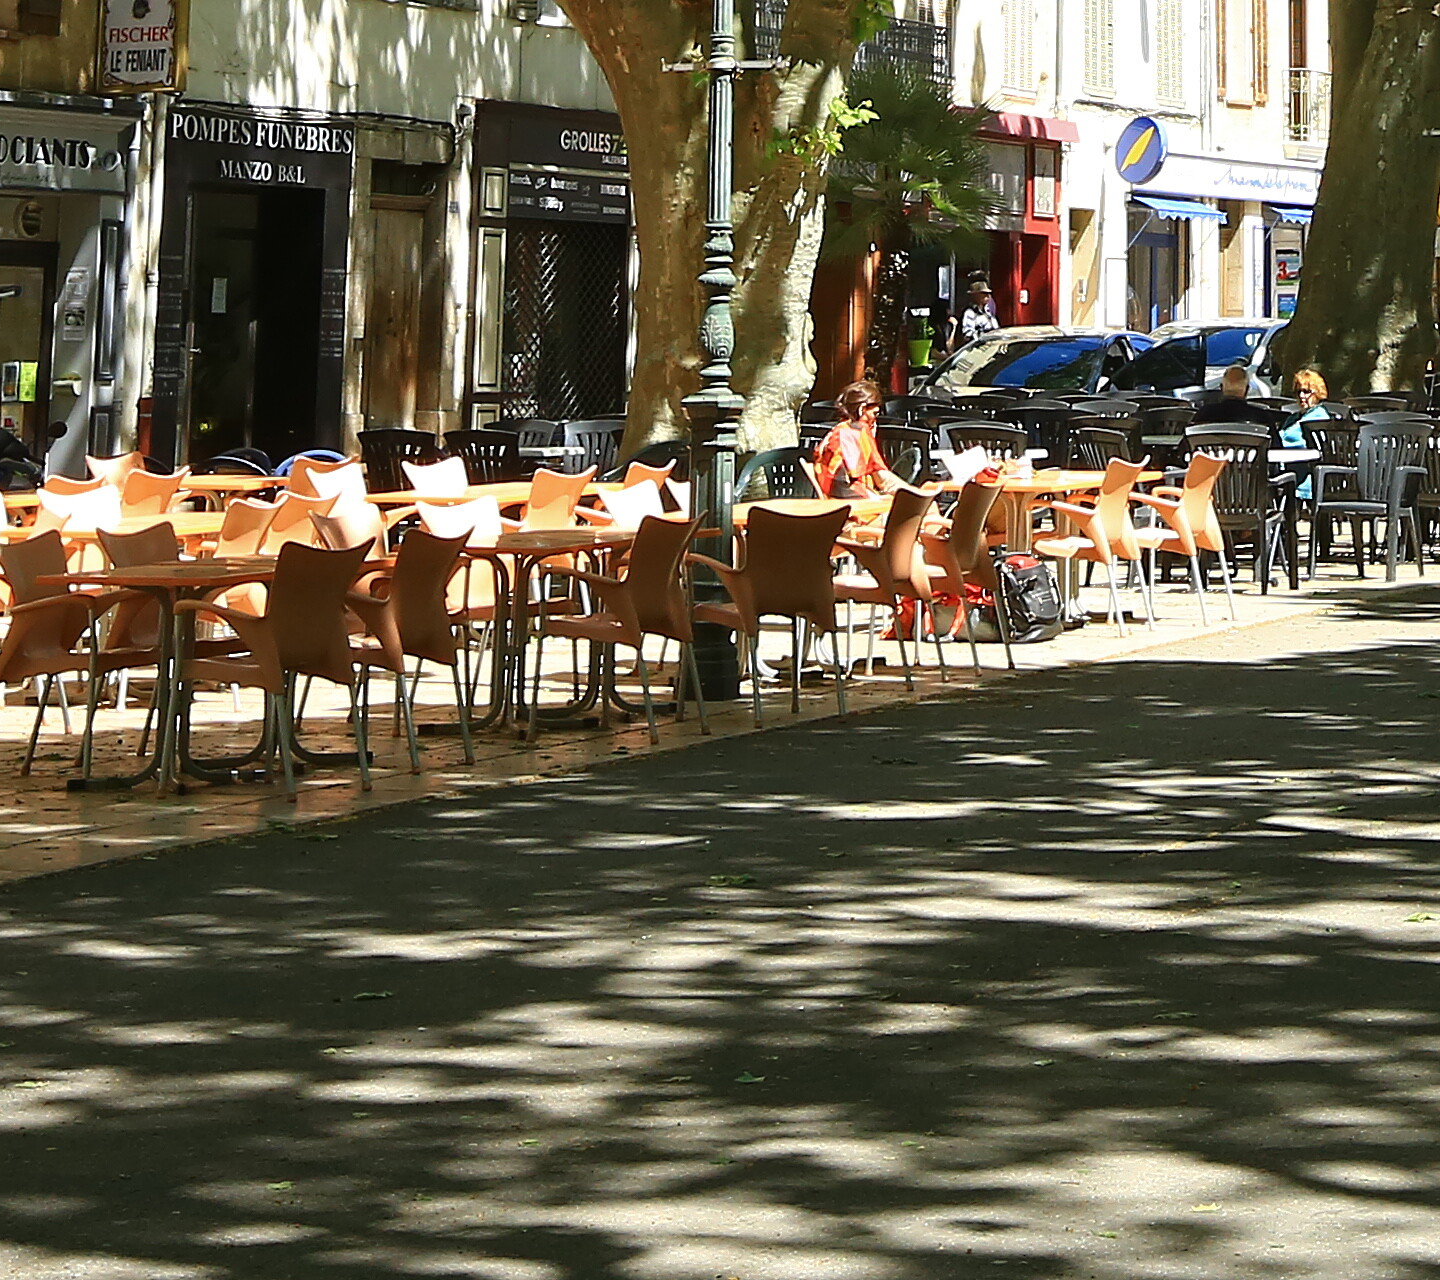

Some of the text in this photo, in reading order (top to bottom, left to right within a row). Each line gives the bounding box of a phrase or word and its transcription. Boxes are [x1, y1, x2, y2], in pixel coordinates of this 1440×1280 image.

[109, 26, 169, 43] FISCHER
[111, 49, 167, 72] LE FENIANT
[171, 113, 251, 146] POMPES
[560, 129, 612, 154] GROLLES
[220, 159, 306, 184] MANZO B&L
